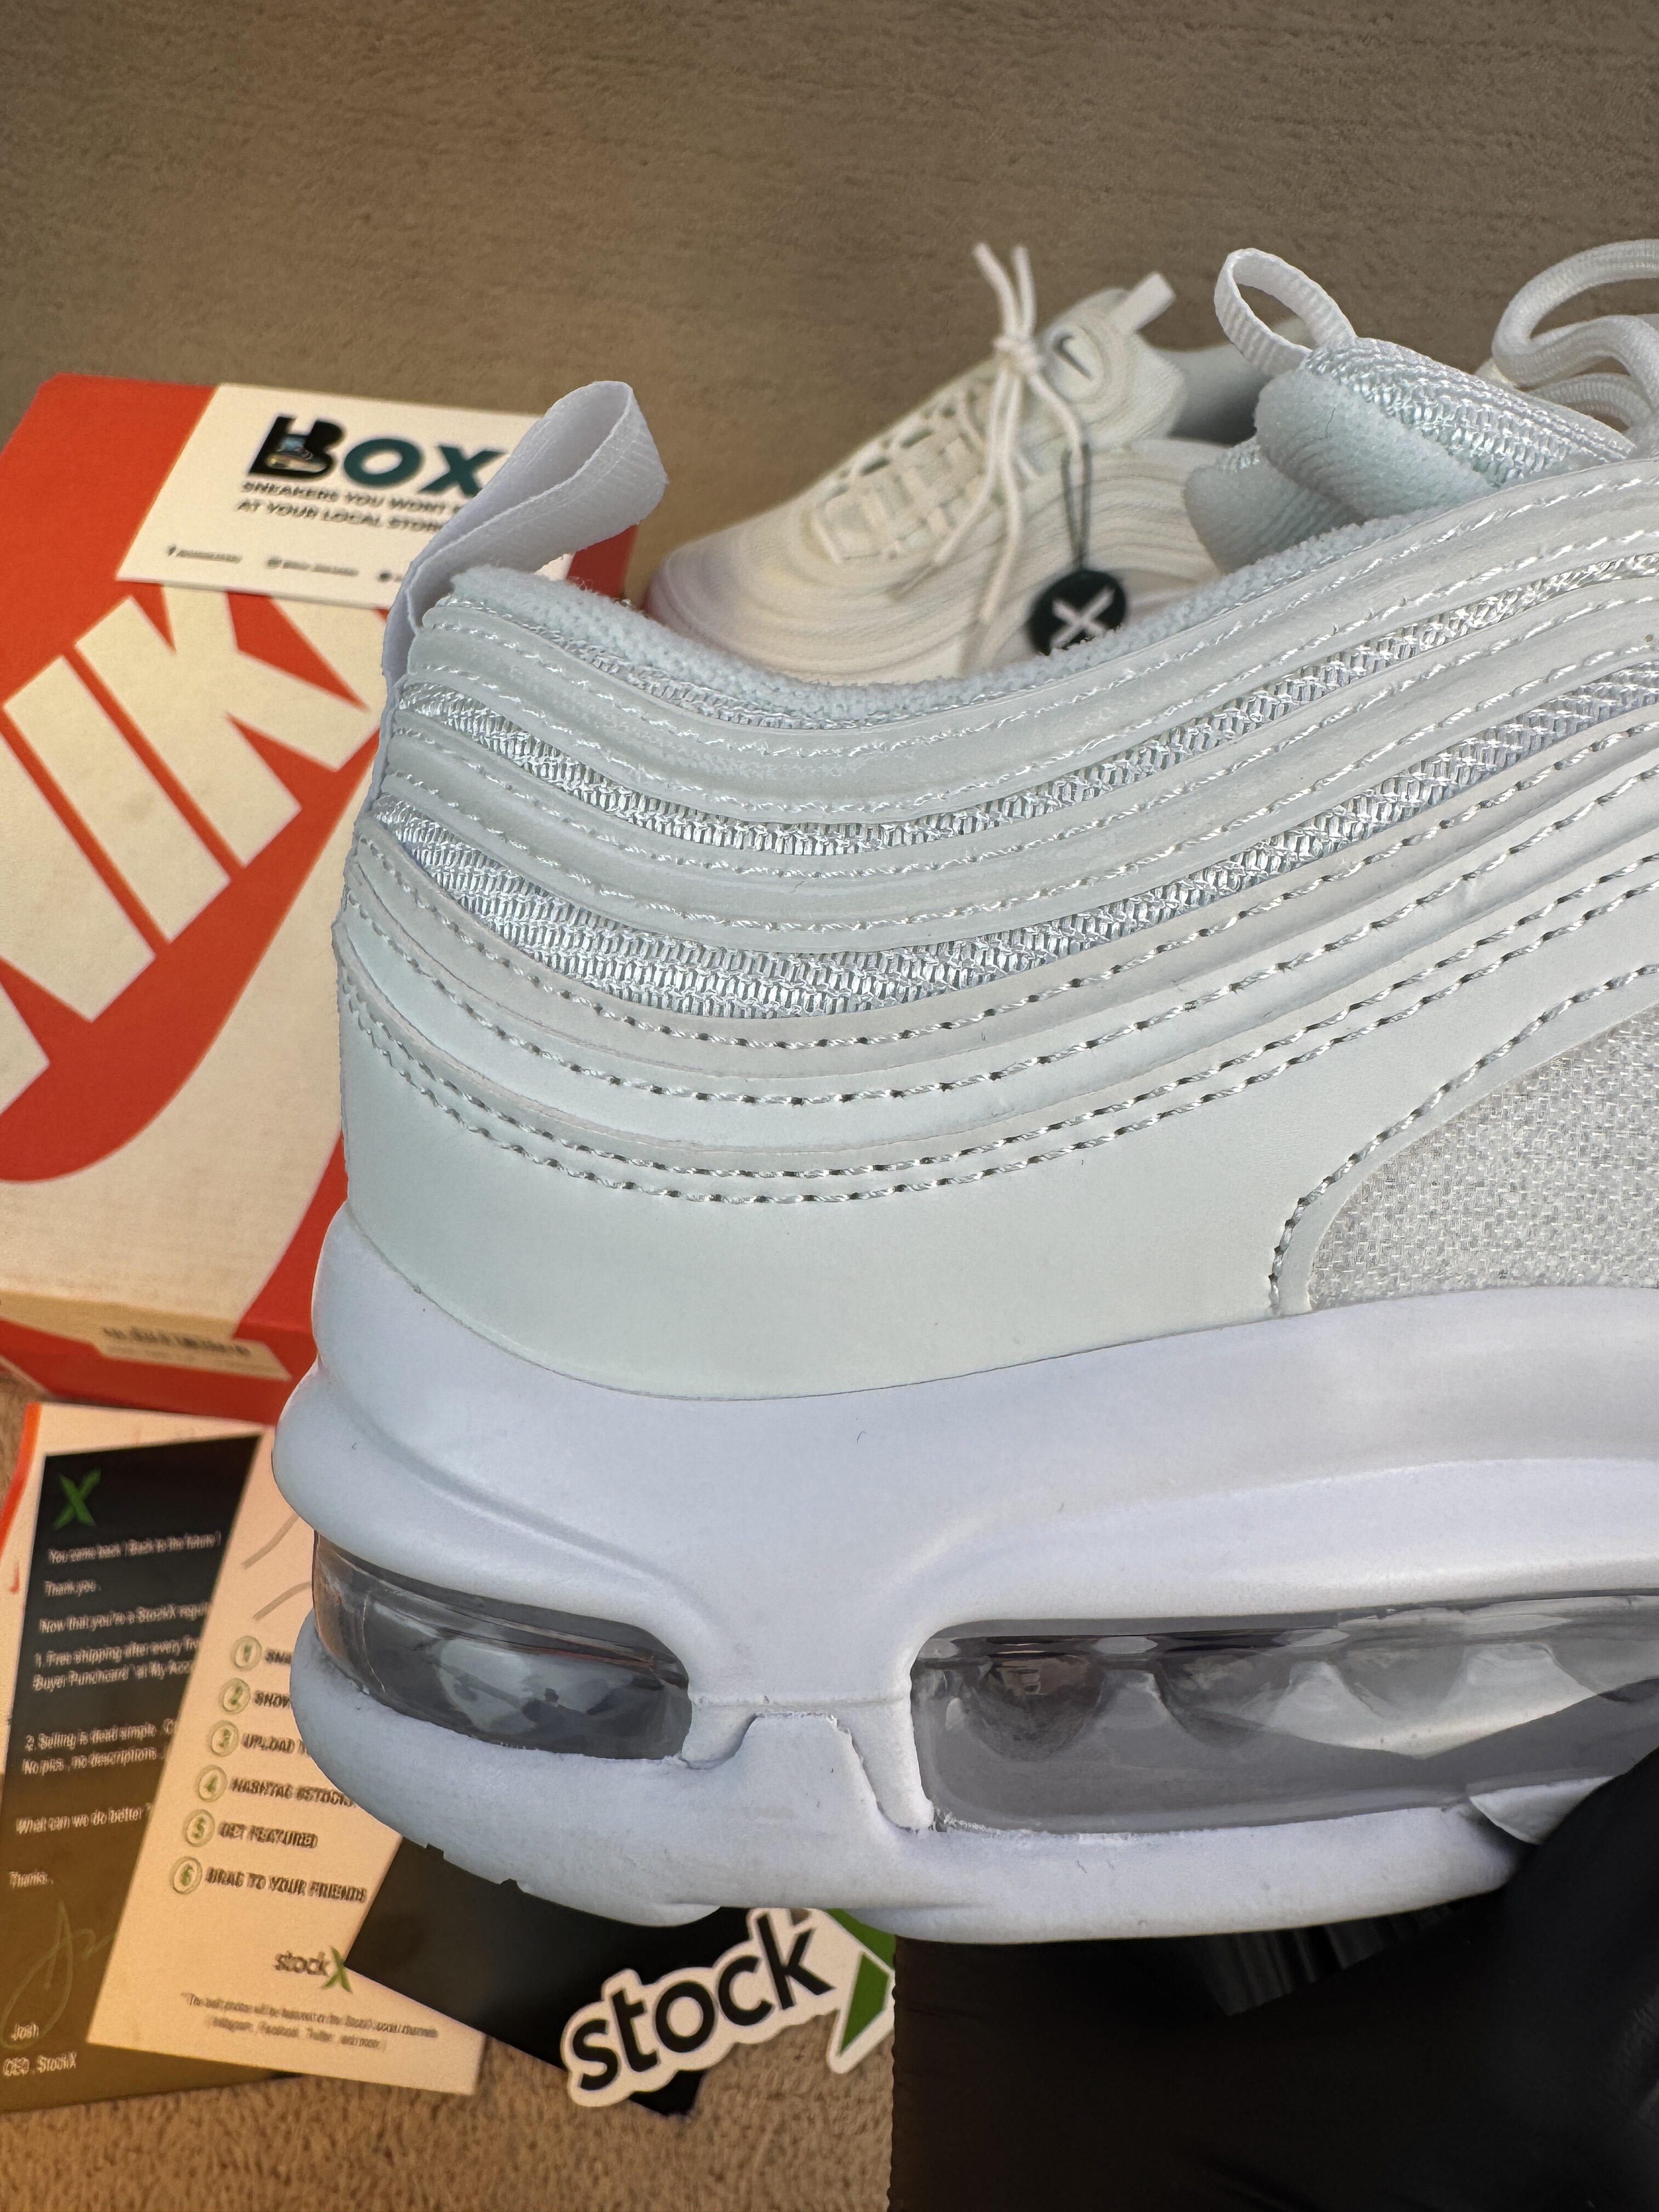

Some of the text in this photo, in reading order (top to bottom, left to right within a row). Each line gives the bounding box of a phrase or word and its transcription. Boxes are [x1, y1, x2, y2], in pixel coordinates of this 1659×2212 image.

[238, 498, 261, 512] AT
[345, 490, 384, 508] YOU
[16, 1816, 47, 1834] What
[71, 1814, 89, 1828] we
[91, 1809, 108, 1825] do
[246, 1872, 267, 1889] TO
[268, 1875, 307, 1896] YOUR
